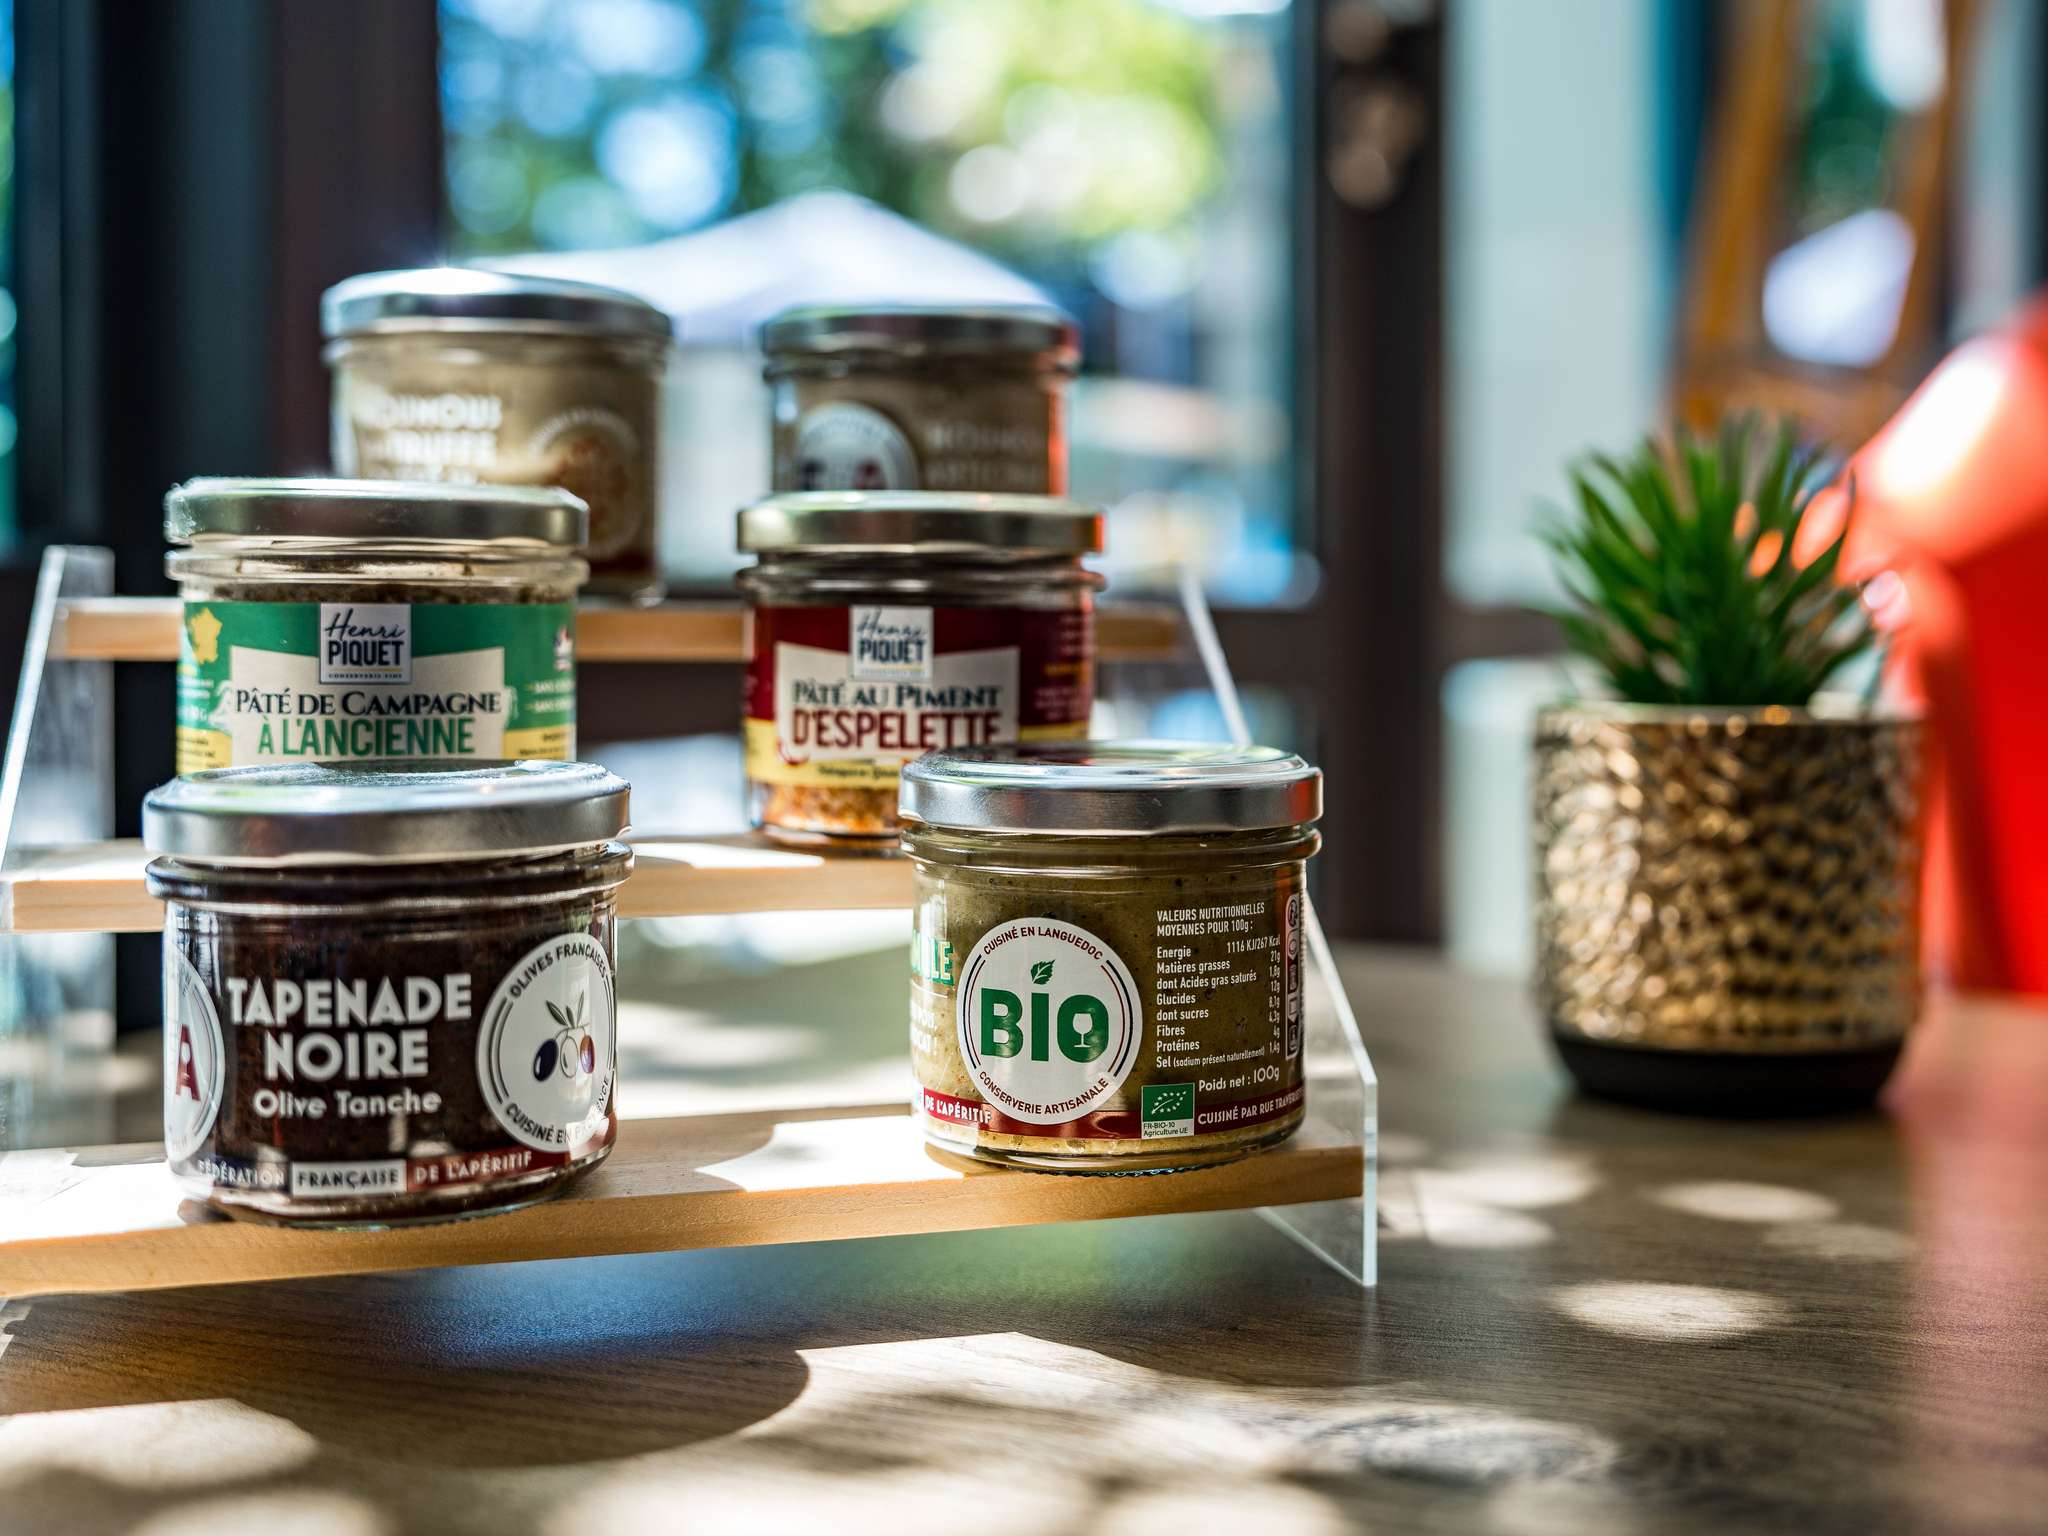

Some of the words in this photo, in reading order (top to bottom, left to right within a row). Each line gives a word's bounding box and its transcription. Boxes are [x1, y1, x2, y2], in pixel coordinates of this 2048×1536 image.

[325, 608, 405, 640] Henri
[328, 641, 404, 667] PIQUET
[858, 640, 927, 665] PIQUET
[236, 689, 291, 714] PÂTÉ
[296, 692, 335, 716] DE
[341, 690, 501, 717] CAMPAGNE
[854, 684, 889, 709] AU
[896, 684, 1003, 709] PIMENT
[257, 717, 275, 755] À
[283, 717, 476, 757] L'ANCIENNE
[1156, 909, 1197, 923] VALEURS
[1199, 902, 1265, 921] NUTRITIONNELLES
[1156, 923, 1205, 938] MOYENNES
[1207, 921, 1230, 935] POUR
[1231, 919, 1250, 934] 100g
[983, 925, 1019, 956] CUISINÉ
[1020, 926, 1036, 938] EN
[1038, 926, 1104, 961] LANGUEDOC
[1156, 945, 1192, 962] Energie
[509, 952, 555, 998] OLIVES
[555, 942, 608, 979] FRANÇAISES
[1156, 961, 1197, 975] Matières
[1198, 959, 1231, 975] grasses
[1156, 976, 1178, 990] dont
[1180, 972, 1210, 989] Acides
[1211, 976, 1230, 988] gras
[1230, 969, 1258, 984] saturés
[225, 973, 473, 1028] TAPENADE
[1156, 993, 1197, 1007] Glucides
[1156, 1008, 1178, 1022] dont
[1180, 1008, 1210, 1018] sucres
[1156, 1024, 1186, 1037] Fibres
[264, 1029, 430, 1083] NOIRE
[1156, 1039, 1200, 1053] Protéines
[1156, 1055, 1172, 1069] Sel
[1173, 1057, 1201, 1068] (sodium
[1202, 1053, 1226, 1067] présent
[1198, 1077, 1227, 1092] Poids
[1229, 1074, 1245, 1088] net
[1253, 1064, 1280, 1084] 100g
[253, 1089, 328, 1120] Olive
[333, 1087, 443, 1119] Tanche
[978, 1071, 1042, 1115] CONSERVERIE
[1044, 1077, 1110, 1115] ARTISANALE
[505, 1102, 553, 1143] CUISINÉ
[936, 1099, 992, 1125] L'APÉRITIF
[1197, 1105, 1239, 1125] CUISINÉ
[1241, 1104, 1258, 1119] PAR
[1259, 1099, 1275, 1114] RUE
[1143, 1129, 1179, 1137] Agriculture
[299, 1168, 399, 1192] FRANÇAISE
[415, 1165, 440, 1184] DE
[446, 1150, 534, 1182] L'APÉRITIF
